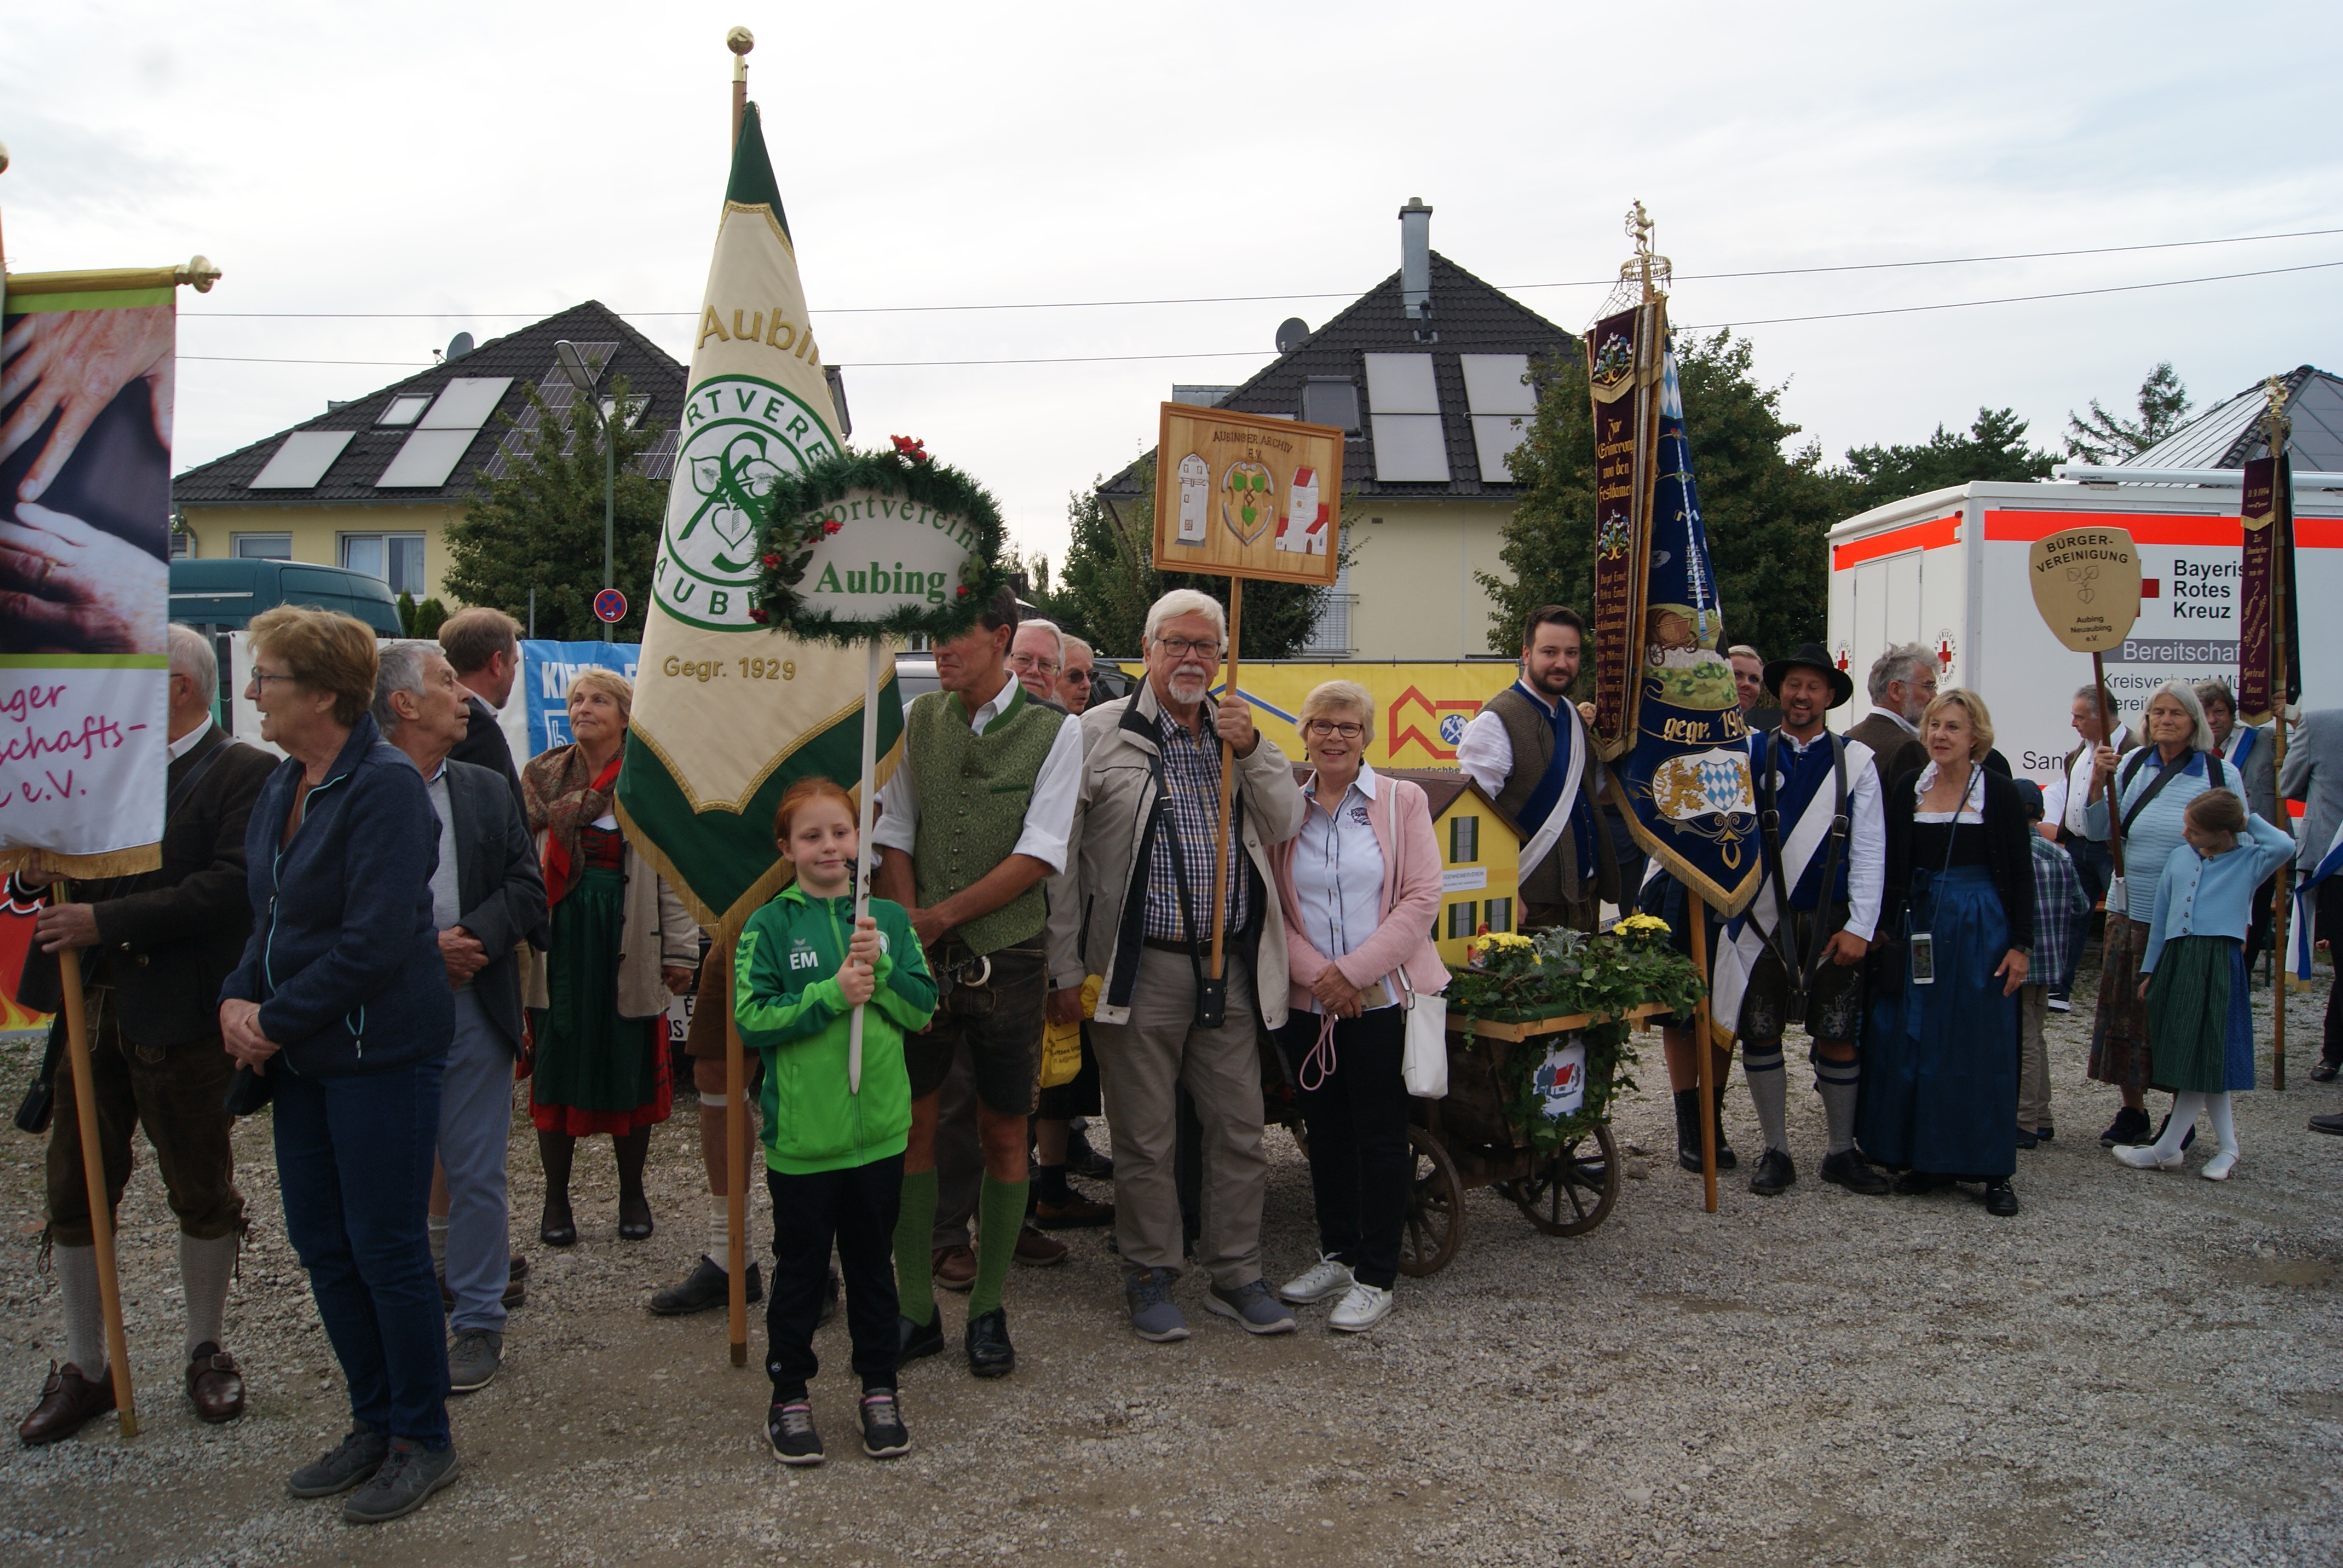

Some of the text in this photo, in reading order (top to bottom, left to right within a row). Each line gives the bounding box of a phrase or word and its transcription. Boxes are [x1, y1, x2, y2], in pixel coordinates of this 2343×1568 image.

[677, 388, 827, 462] RTVERE
[1213, 431, 1293, 453] AUBINGER ARCHIV
[1248, 449, 1262, 460] E.V.
[794, 494, 976, 550] portverein
[2046, 535, 2114, 553] BÜRGER-
[2036, 550, 2128, 572] VEREINIGUNG
[655, 557, 758, 615] AUBI
[813, 560, 948, 604] Aubing
[2174, 581, 2230, 598] Rotes
[2174, 601, 2231, 619] Kreuz
[1934, 631, 1956, 656] AYERISCHES
[2123, 641, 2241, 661] Bereitschaf
[663, 655, 727, 682] Gegr.
[738, 656, 796, 681] 1929
[1663, 708, 1745, 745] gegr. 196
[2022, 751, 2068, 770] San
[22, 769, 87, 803] e.V.
[789, 951, 819, 970] EM
